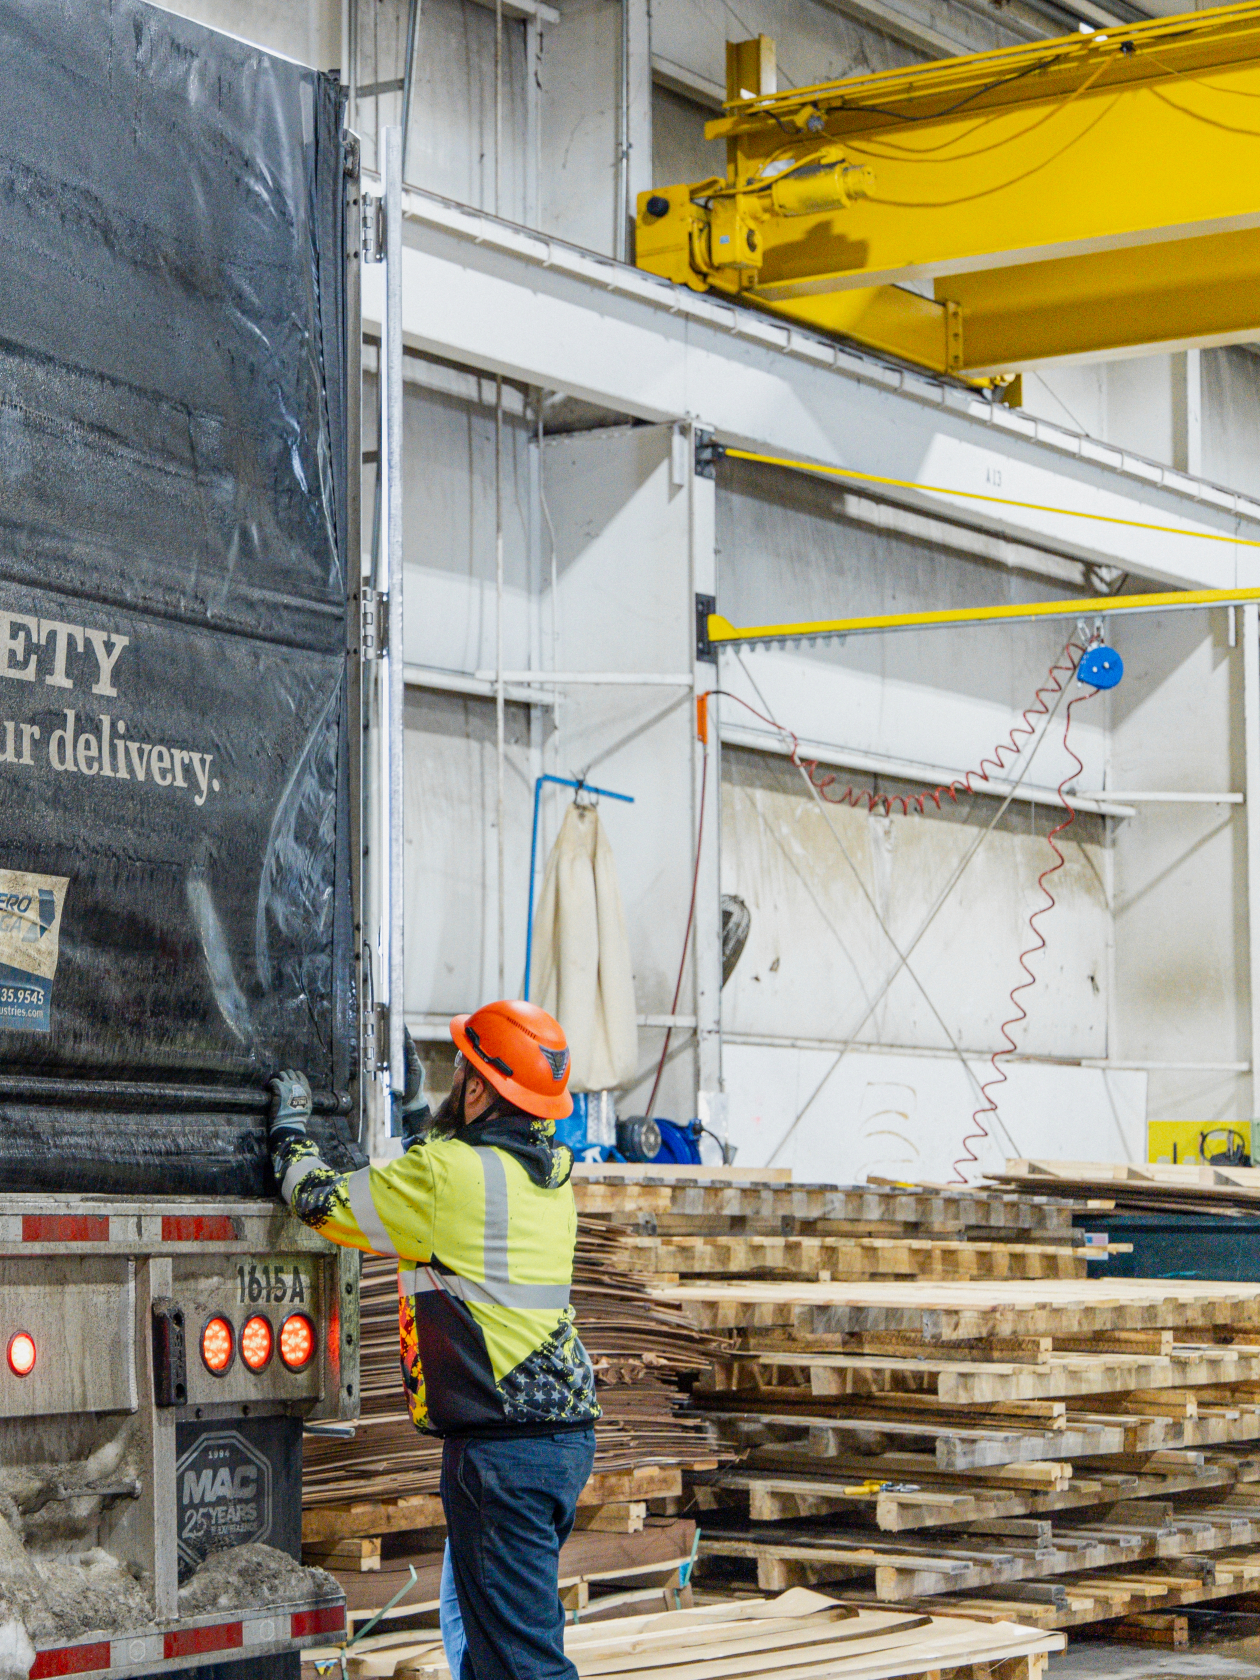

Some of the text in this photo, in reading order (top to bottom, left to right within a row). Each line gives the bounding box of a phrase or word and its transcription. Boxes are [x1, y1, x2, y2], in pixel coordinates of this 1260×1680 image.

[49, 709, 220, 806] delivery.
[237, 1265, 305, 1303] 1615A
[183, 1465, 257, 1505] MAC
[181, 1508, 207, 1538] 25
[207, 1502, 258, 1524] YEARS
